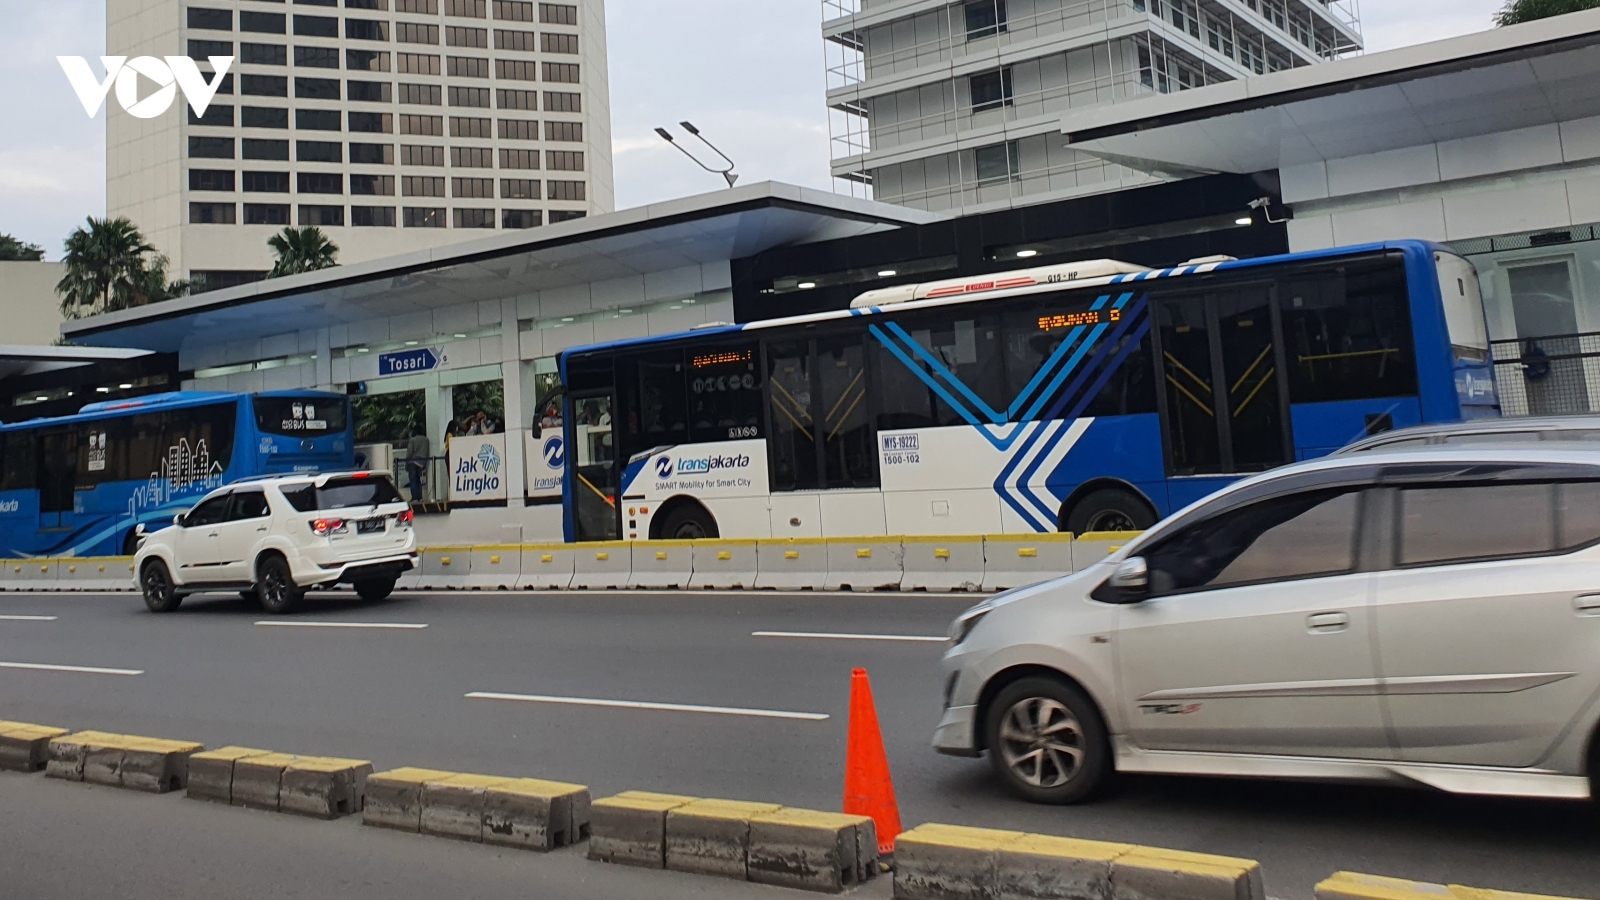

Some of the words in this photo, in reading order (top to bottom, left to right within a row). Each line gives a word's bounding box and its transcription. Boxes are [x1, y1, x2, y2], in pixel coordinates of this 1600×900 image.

[389, 353, 426, 371] Tosari
[884, 436, 916, 448] MYS-19222
[455, 457, 477, 474] Jak
[677, 454, 749, 475] transjakarta
[884, 455, 919, 465] 1500-102
[456, 474, 499, 495] Lingko
[655, 481, 677, 490] SMART
[679, 481, 705, 489] Mobility
[706, 480, 715, 488] for
[738, 478, 751, 487] City
